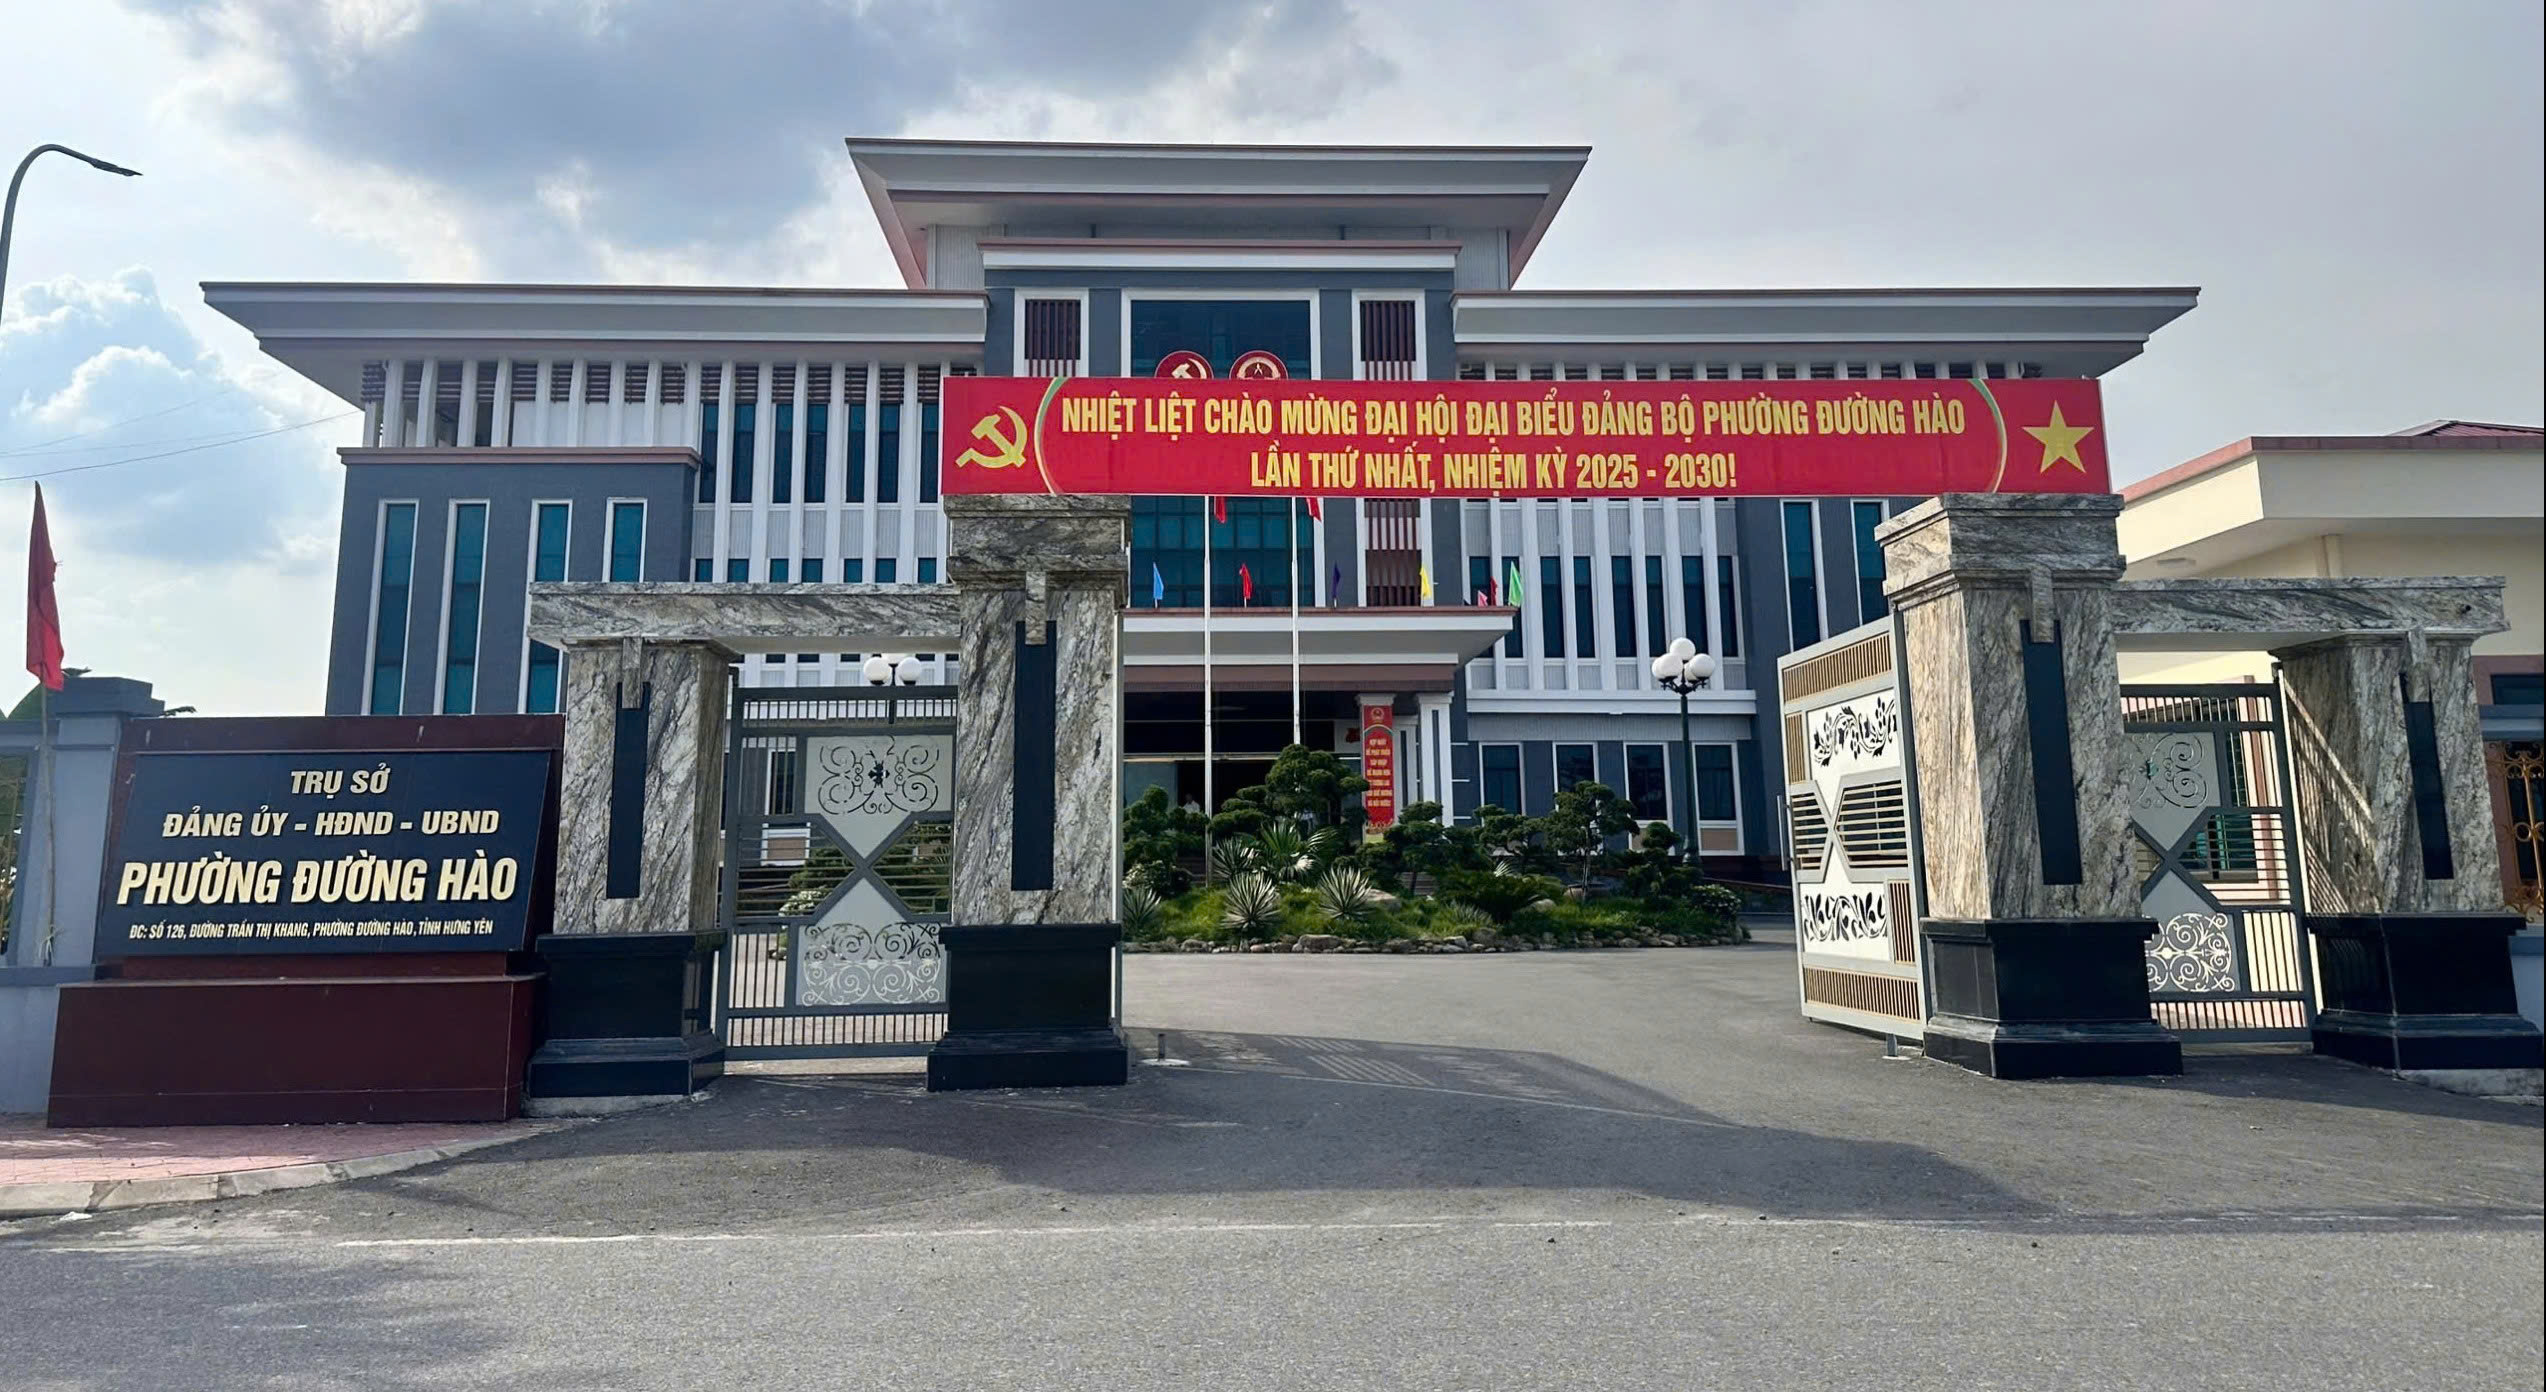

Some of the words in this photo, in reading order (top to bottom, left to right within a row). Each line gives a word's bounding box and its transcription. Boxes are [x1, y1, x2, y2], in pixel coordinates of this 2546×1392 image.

[1062, 390, 1137, 440] NHIỆT
[1145, 391, 1196, 440] LIỆT
[1204, 392, 1272, 434] CHÀO
[1281, 393, 1357, 435] MỪNG
[1365, 400, 1407, 443] ĐẠI
[1415, 394, 1457, 443] HỘI
[1466, 401, 1508, 443] ĐẠI
[1517, 387, 1574, 435] BIỂU
[1582, 390, 1653, 435] ĐẢNG
[1661, 394, 1695, 443] BỘ
[1703, 392, 1809, 435] PHƯỜNG
[1816, 392, 1905, 434] ĐƯỜNG
[1913, 392, 1965, 434] HÀO
[1251, 440, 1300, 487] LẦN
[1308, 445, 1359, 488] THỨ
[1365, 441, 1435, 493] NHẤT,
[1444, 446, 1527, 496] NHIỆM
[1536, 446, 1567, 488] KỲ
[1576, 453, 1638, 488] 2025
[1647, 469, 1656, 477] -
[1664, 453, 1737, 488] 2030!
[291, 771, 343, 799] TRỤ
[350, 763, 391, 794] SỞ
[162, 805, 243, 837] ĐẢNG
[251, 805, 288, 836] ỦY
[294, 823, 307, 831] -
[315, 811, 394, 836] HĐND
[400, 822, 413, 830] -
[421, 810, 499, 835] UBND
[117, 851, 282, 904] PHƯỜNG
[291, 850, 428, 903] ĐƯỜNG
[437, 849, 517, 901] HÀO
[129, 924, 147, 939] ĐC:
[149, 919, 166, 938] SỐ
[189, 920, 225, 938] ĐƯỜNG
[313, 918, 354, 936] PHƯỜNG
[356, 918, 391, 936] ĐƯỜNG
[418, 917, 442, 935] TỈNH
[443, 919, 471, 935] HƯNG
[473, 917, 493, 935] YÊN
